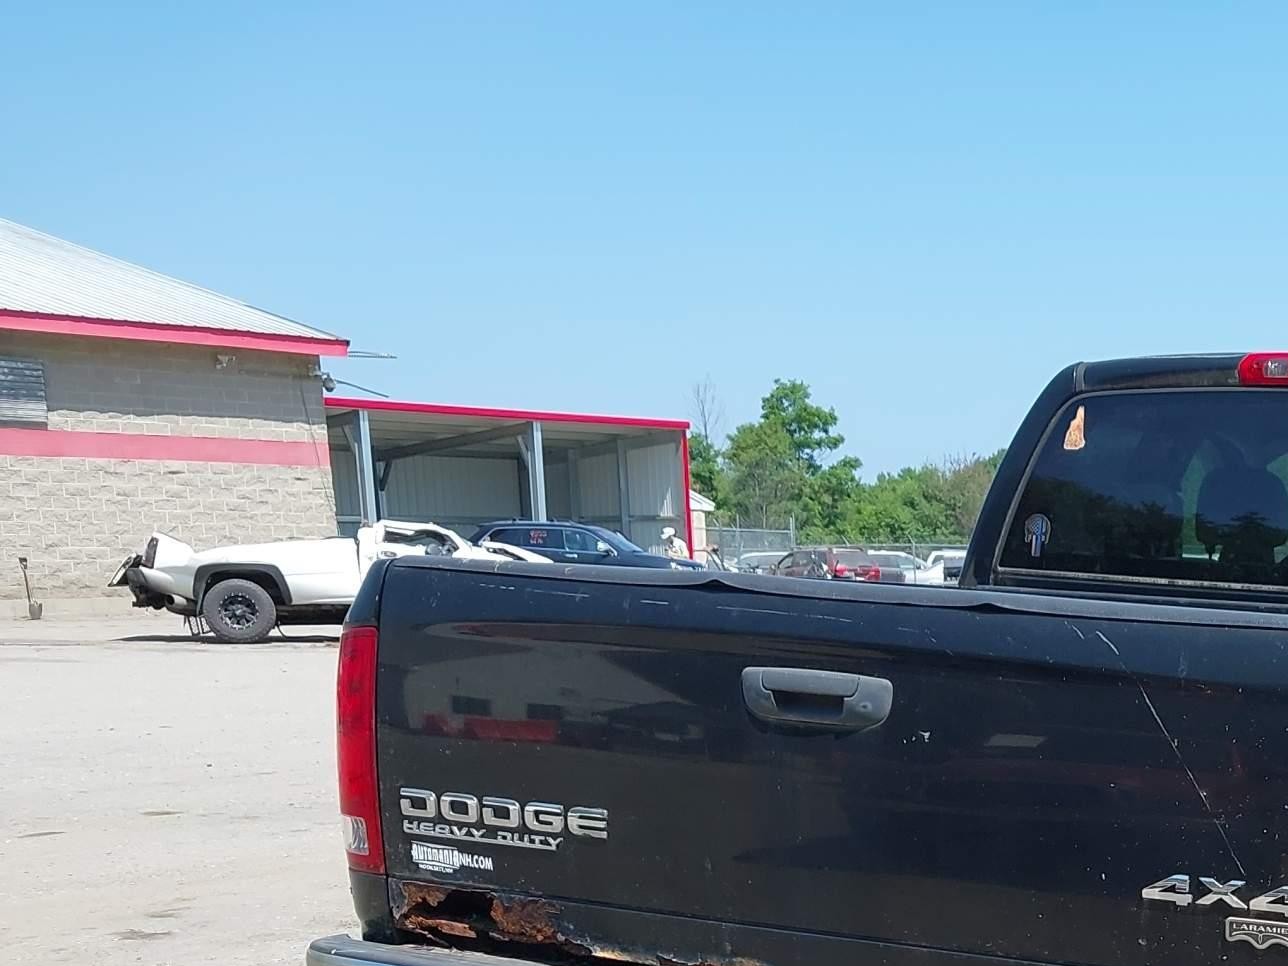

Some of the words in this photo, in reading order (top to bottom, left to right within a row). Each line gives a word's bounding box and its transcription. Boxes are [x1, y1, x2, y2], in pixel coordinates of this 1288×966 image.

[400, 787, 608, 839] DODGE
[403, 819, 486, 840] HEAVY
[497, 830, 563, 848] DUTY
[1232, 922, 1288, 935] LARAMIE
